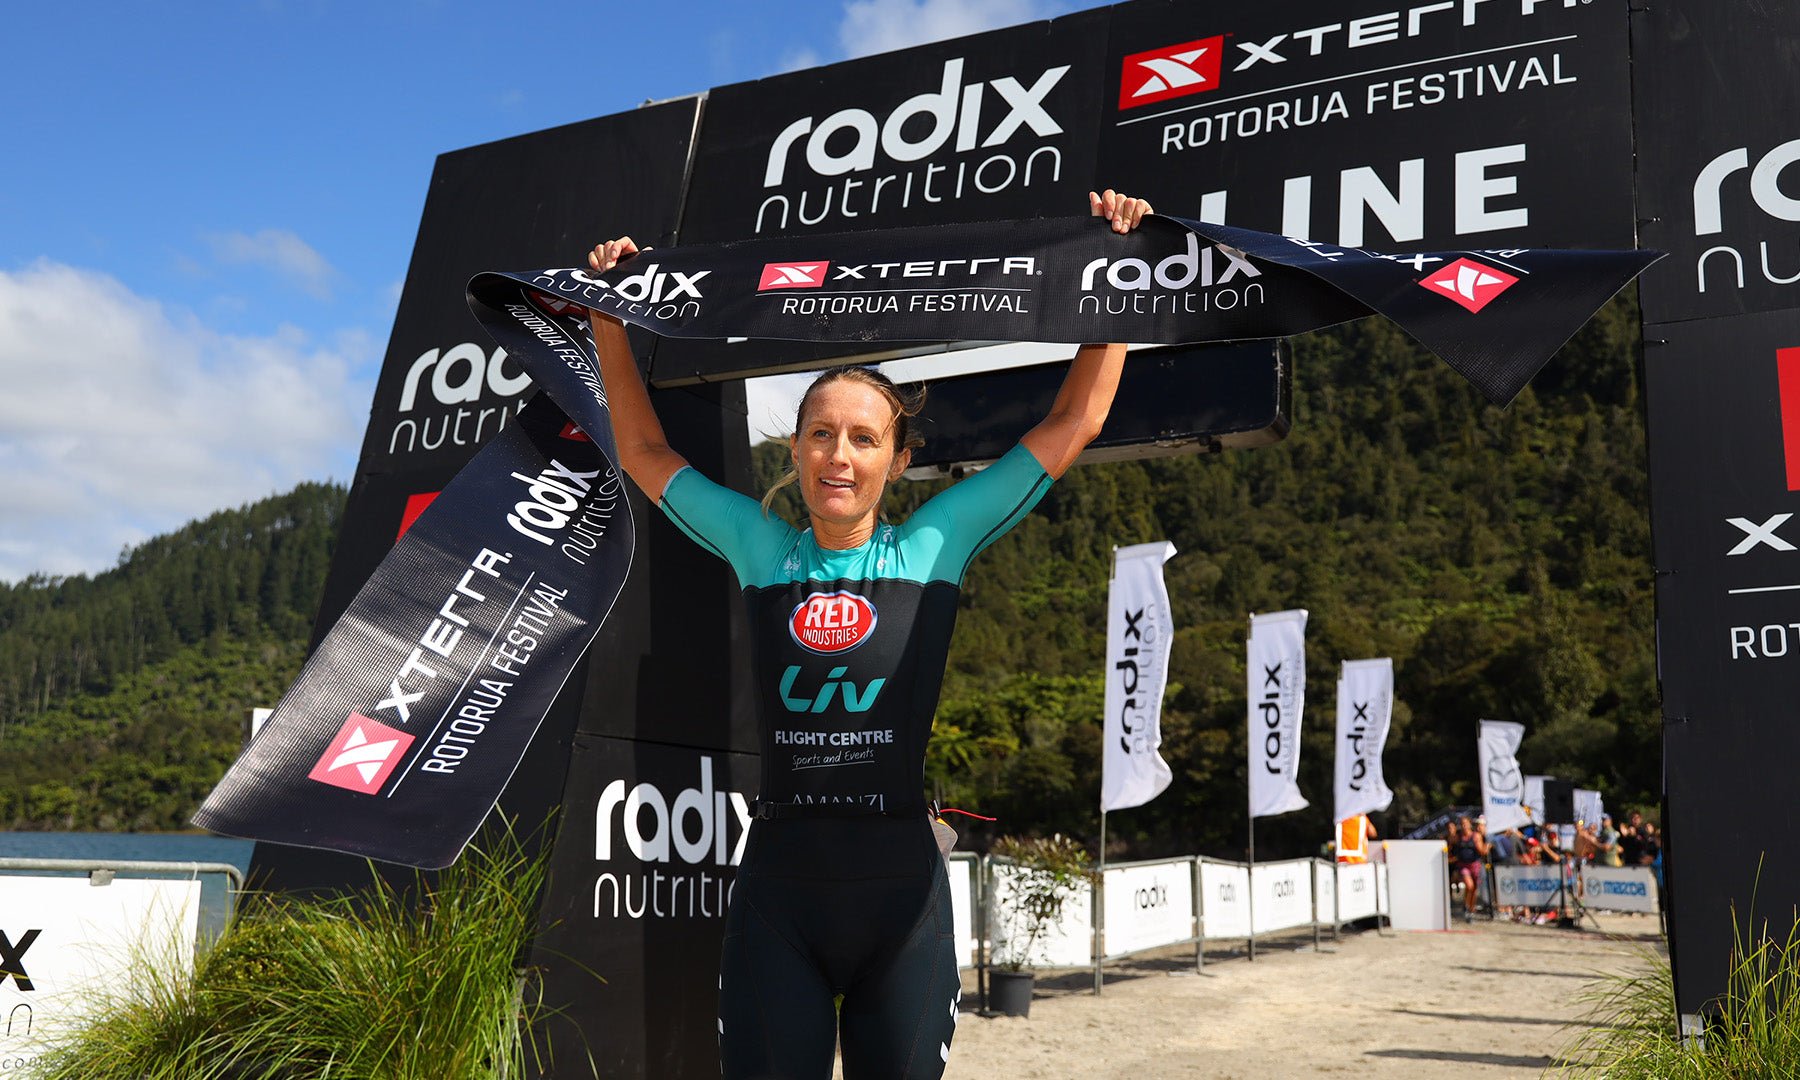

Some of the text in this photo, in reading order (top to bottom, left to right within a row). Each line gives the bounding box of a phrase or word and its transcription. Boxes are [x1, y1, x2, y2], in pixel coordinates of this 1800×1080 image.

[763, 57, 1072, 188] radix
[1161, 53, 1578, 154] ROTORUA FESTIVAL
[755, 146, 1062, 234] nutrition
[832, 257, 1035, 280] XTERRA
[1081, 231, 1262, 292] radix
[532, 275, 700, 320] nutrition
[782, 293, 1029, 315] ROTORUA FESTIVAL
[1078, 283, 1264, 315] nutrition
[504, 303, 567, 347] ROTORUA
[553, 347, 611, 413] FESTIVAL
[506, 459, 600, 547] radix
[375, 547, 511, 723] XTERRA
[802, 627, 858, 647] INDUSTRIES
[804, 599, 859, 628] RED
[421, 581, 568, 774] ROTORUA FESTIVAL
[778, 665, 887, 713] Liv
[775, 729, 893, 746] FLIGHT CENTRE
[1258, 662, 1282, 774] radix
[792, 747, 874, 768] Sports and Events
[593, 869, 735, 919] nutriti
[1603, 880, 1647, 896] mazda
